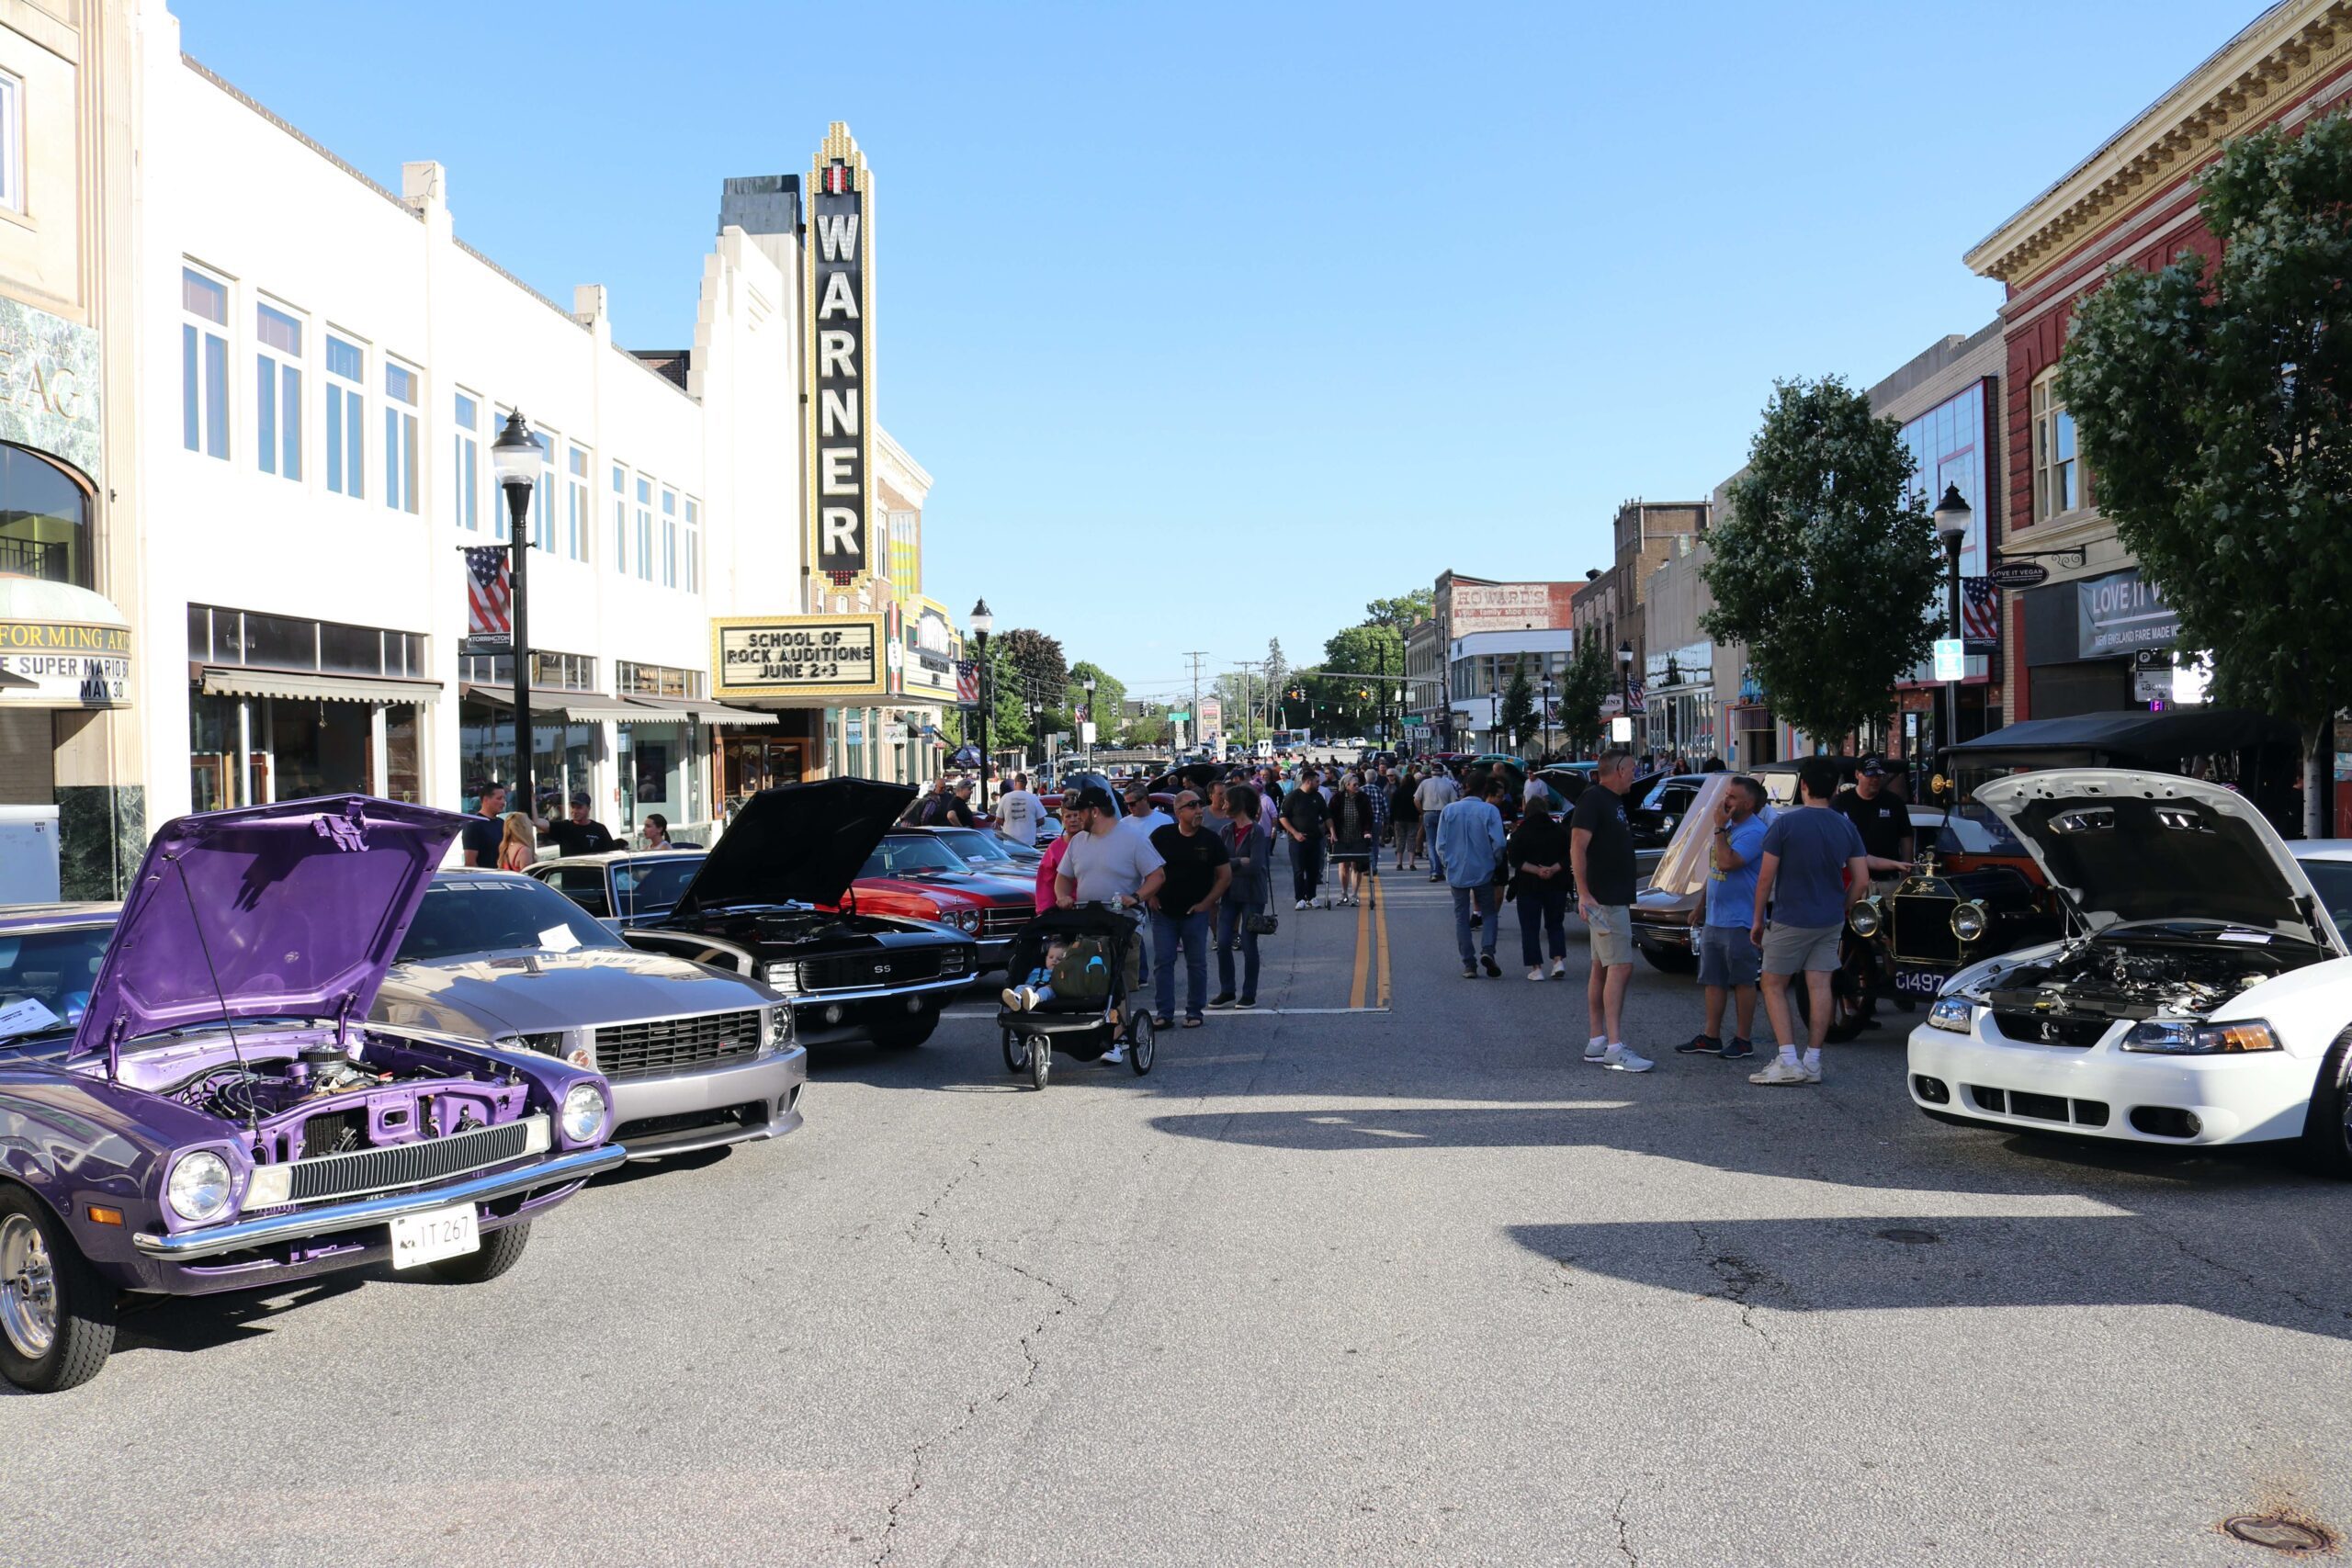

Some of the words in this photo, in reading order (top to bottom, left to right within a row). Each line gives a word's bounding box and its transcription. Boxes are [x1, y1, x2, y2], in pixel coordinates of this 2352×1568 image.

[817, 213, 860, 556] WARNER
[1457, 591, 1544, 605] HOWARD'S
[2093, 582, 2130, 615] LOVE
[1479, 608, 1502, 616] family
[1505, 608, 1521, 616] shoe
[748, 632, 816, 648] SCHOOL
[820, 632, 842, 646] OF
[2096, 636, 2107, 647] NEW
[2109, 630, 2134, 645] ENGLAND
[2135, 627, 2152, 641] FARE
[2152, 625, 2170, 639] MADE
[727, 649, 772, 664] ROCK
[779, 647, 873, 662] AUDITIONS
[19, 657, 77, 675] SUPER
[84, 659, 121, 678] MARIO
[759, 664, 804, 679] JUNE
[81, 680, 108, 698] MAY
[113, 682, 123, 698] 30
[875, 964, 891, 974] SS
[444, 1215, 469, 1243] 267
